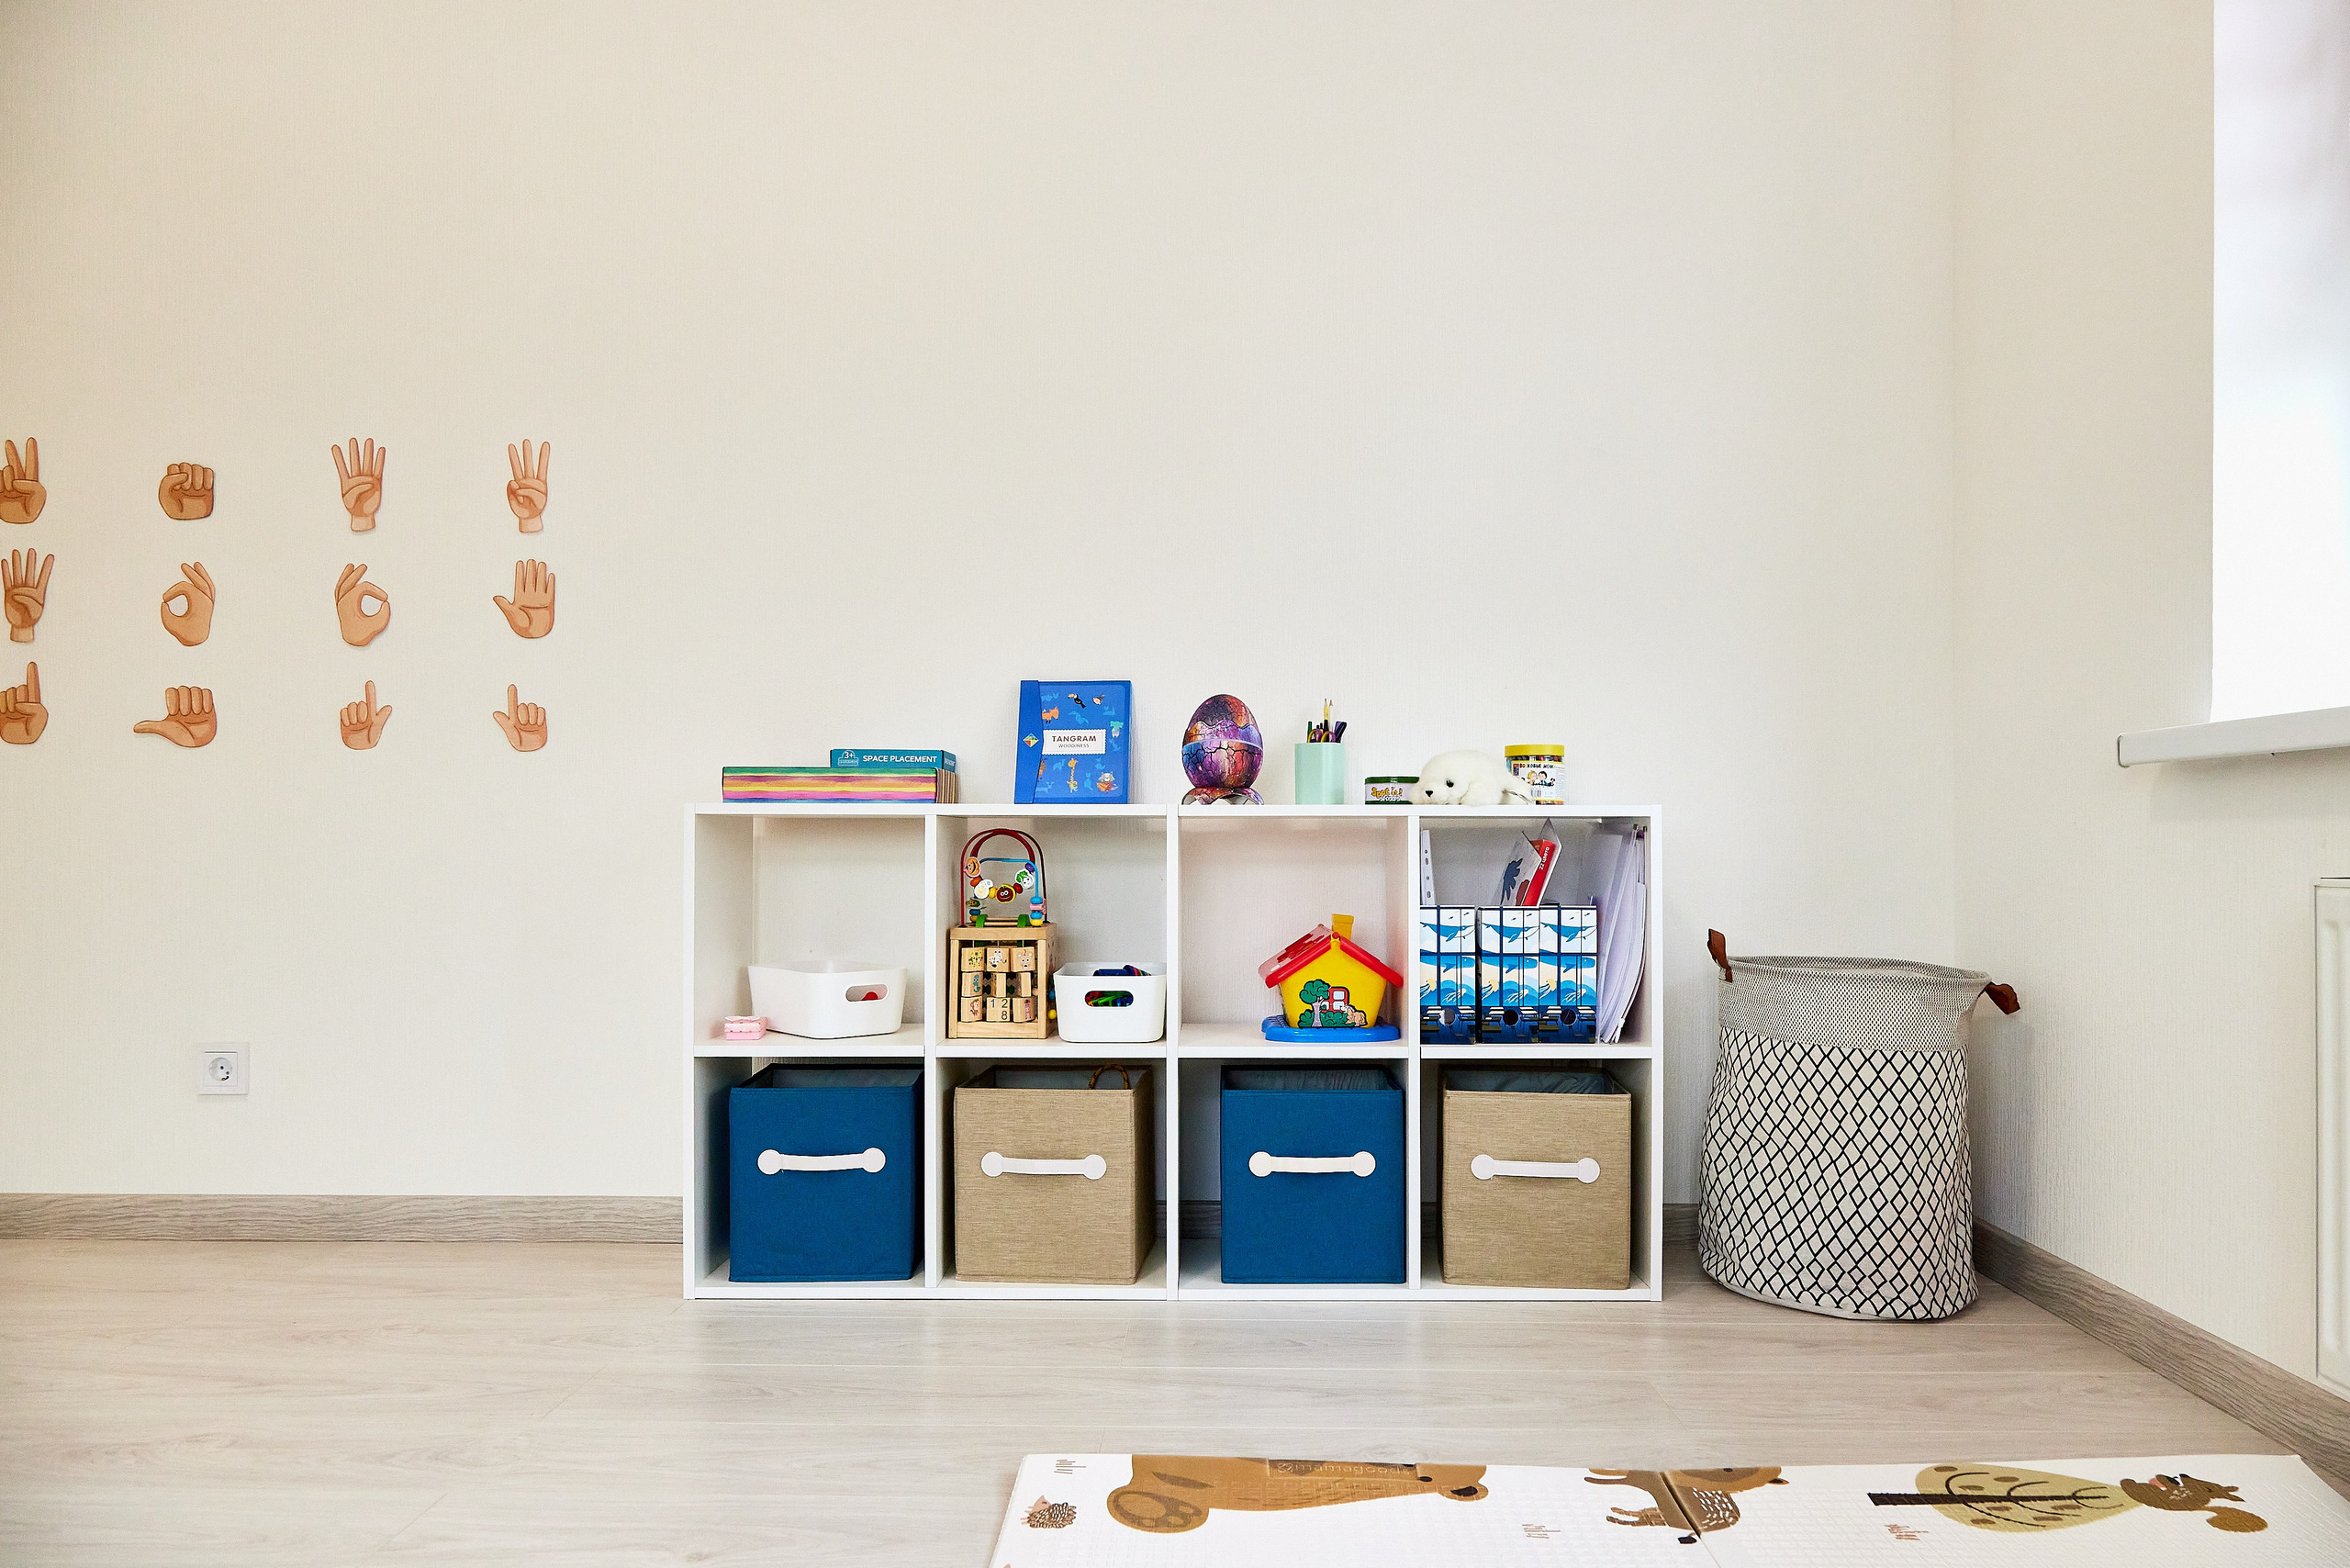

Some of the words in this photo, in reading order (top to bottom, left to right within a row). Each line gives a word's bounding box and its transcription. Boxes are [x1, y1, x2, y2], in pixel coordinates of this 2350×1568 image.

[1371, 787, 1390, 799] Spot
[990, 999, 994, 1008] 1
[1002, 999, 1008, 1008] 2
[1002, 1011, 1007, 1020] 8
